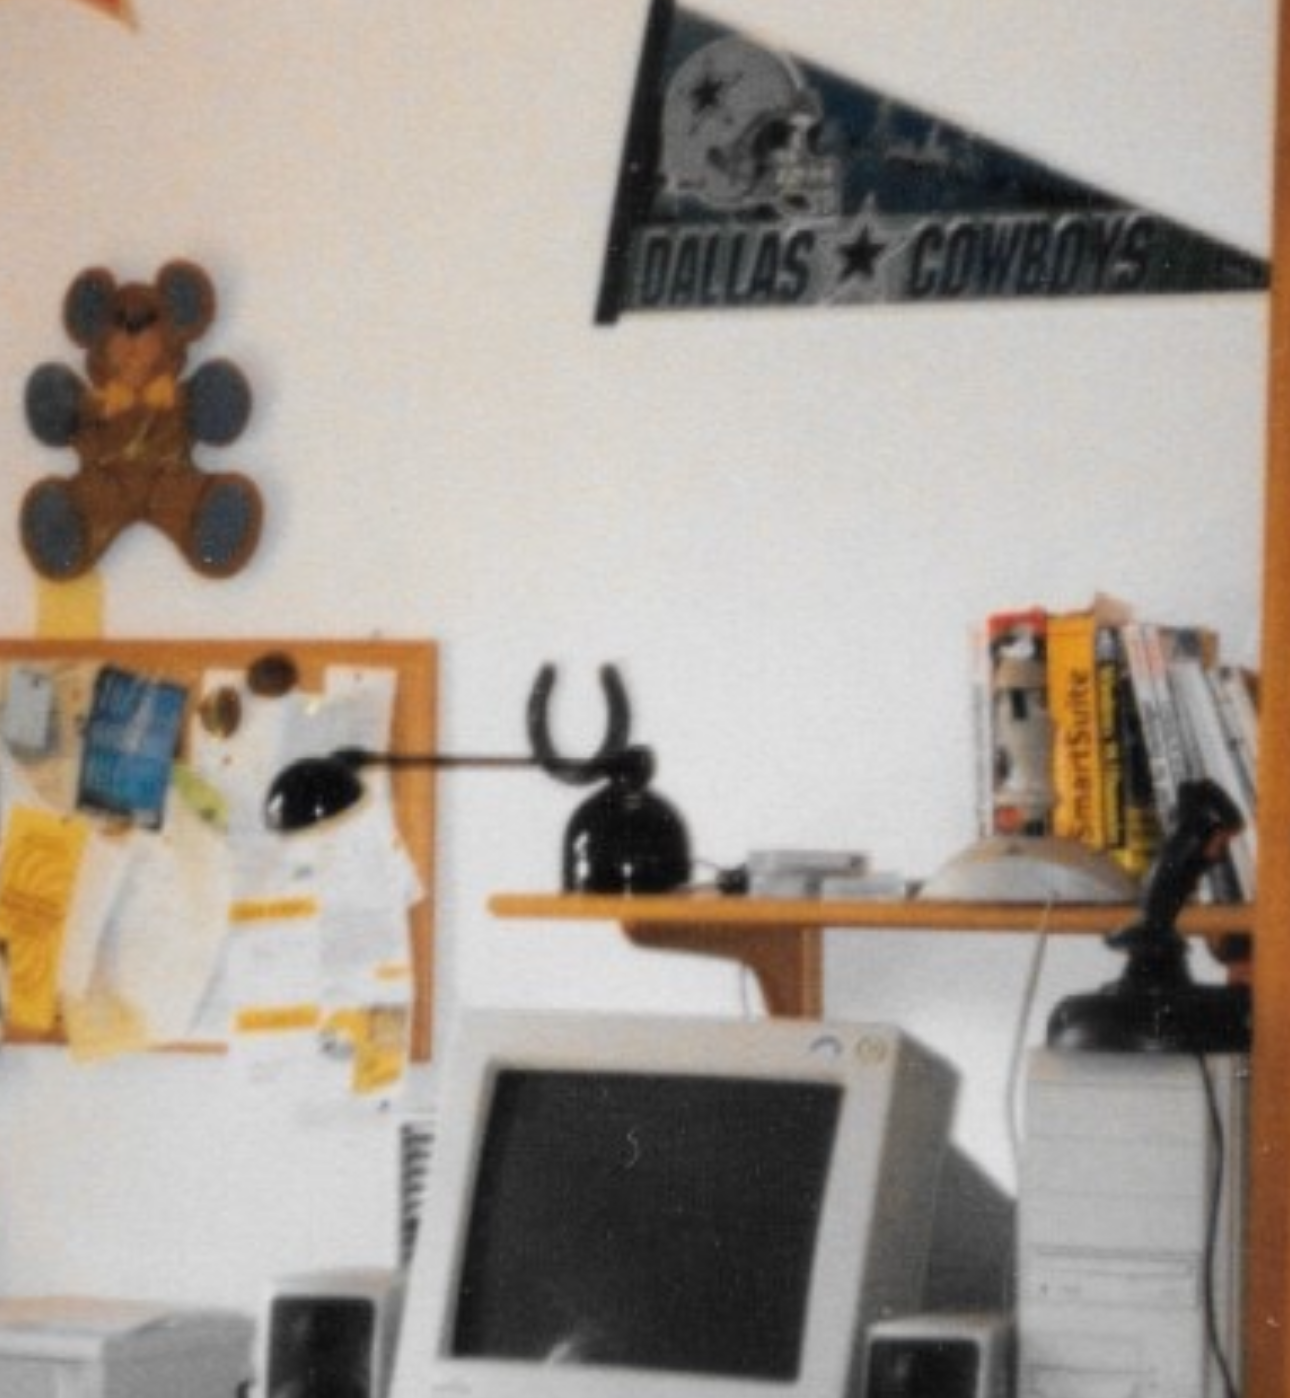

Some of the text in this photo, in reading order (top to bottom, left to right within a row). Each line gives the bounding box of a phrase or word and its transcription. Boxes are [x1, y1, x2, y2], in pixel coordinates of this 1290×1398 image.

[639, 212, 1156, 303] DALLAS COWBOYS
[1066, 669, 1091, 840] SmartSuite
